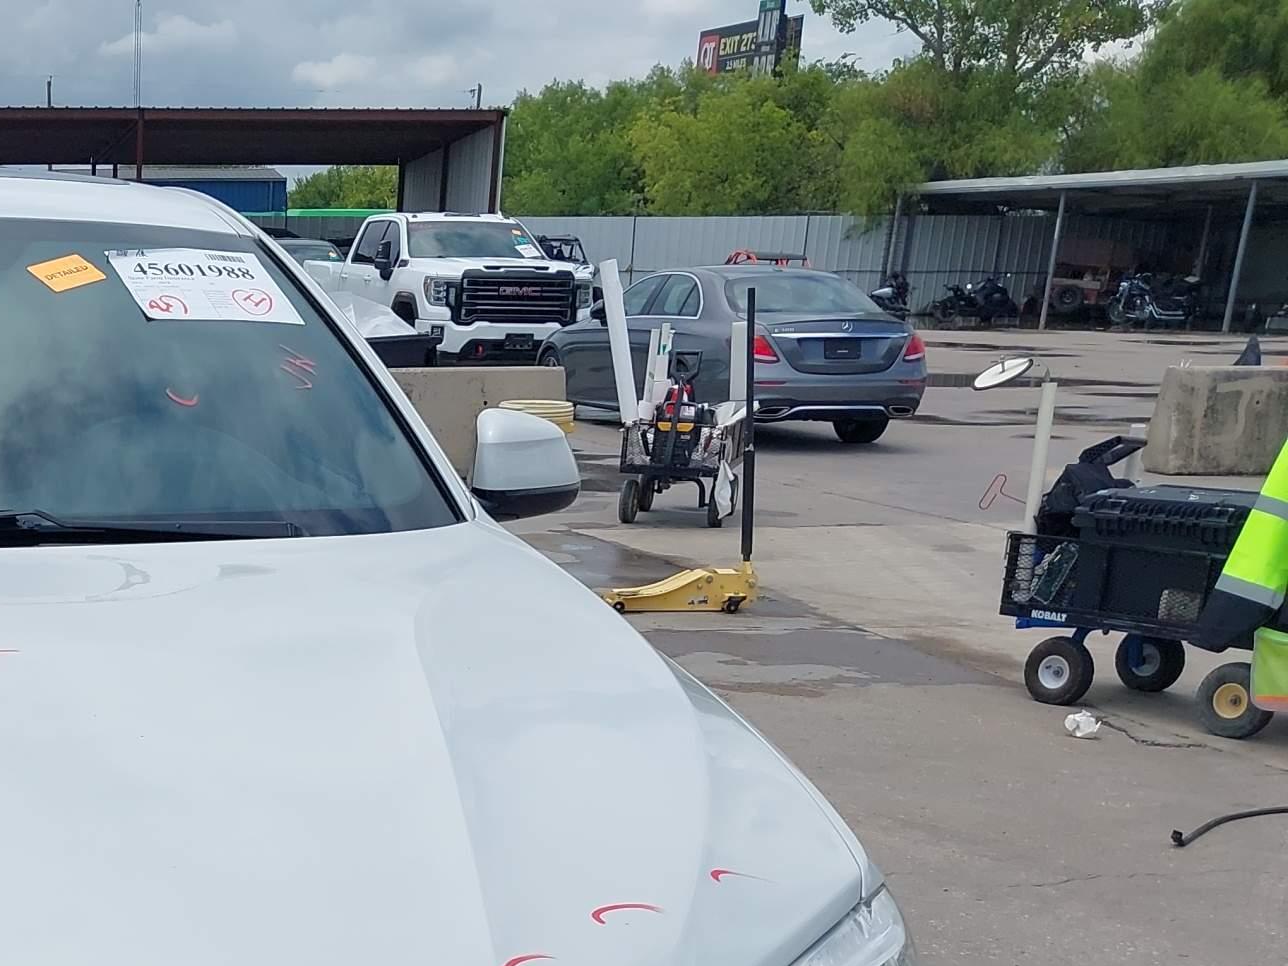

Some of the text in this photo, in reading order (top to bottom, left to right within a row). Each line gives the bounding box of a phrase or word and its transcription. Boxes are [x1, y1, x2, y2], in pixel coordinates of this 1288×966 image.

[720, 35, 738, 55] EXIT
[701, 42, 715, 70] QT
[45, 265, 89, 280] DETAILED
[133, 262, 255, 280] 45601988
[499, 286, 542, 297] GMC
[1031, 609, 1067, 622] KOBALT
